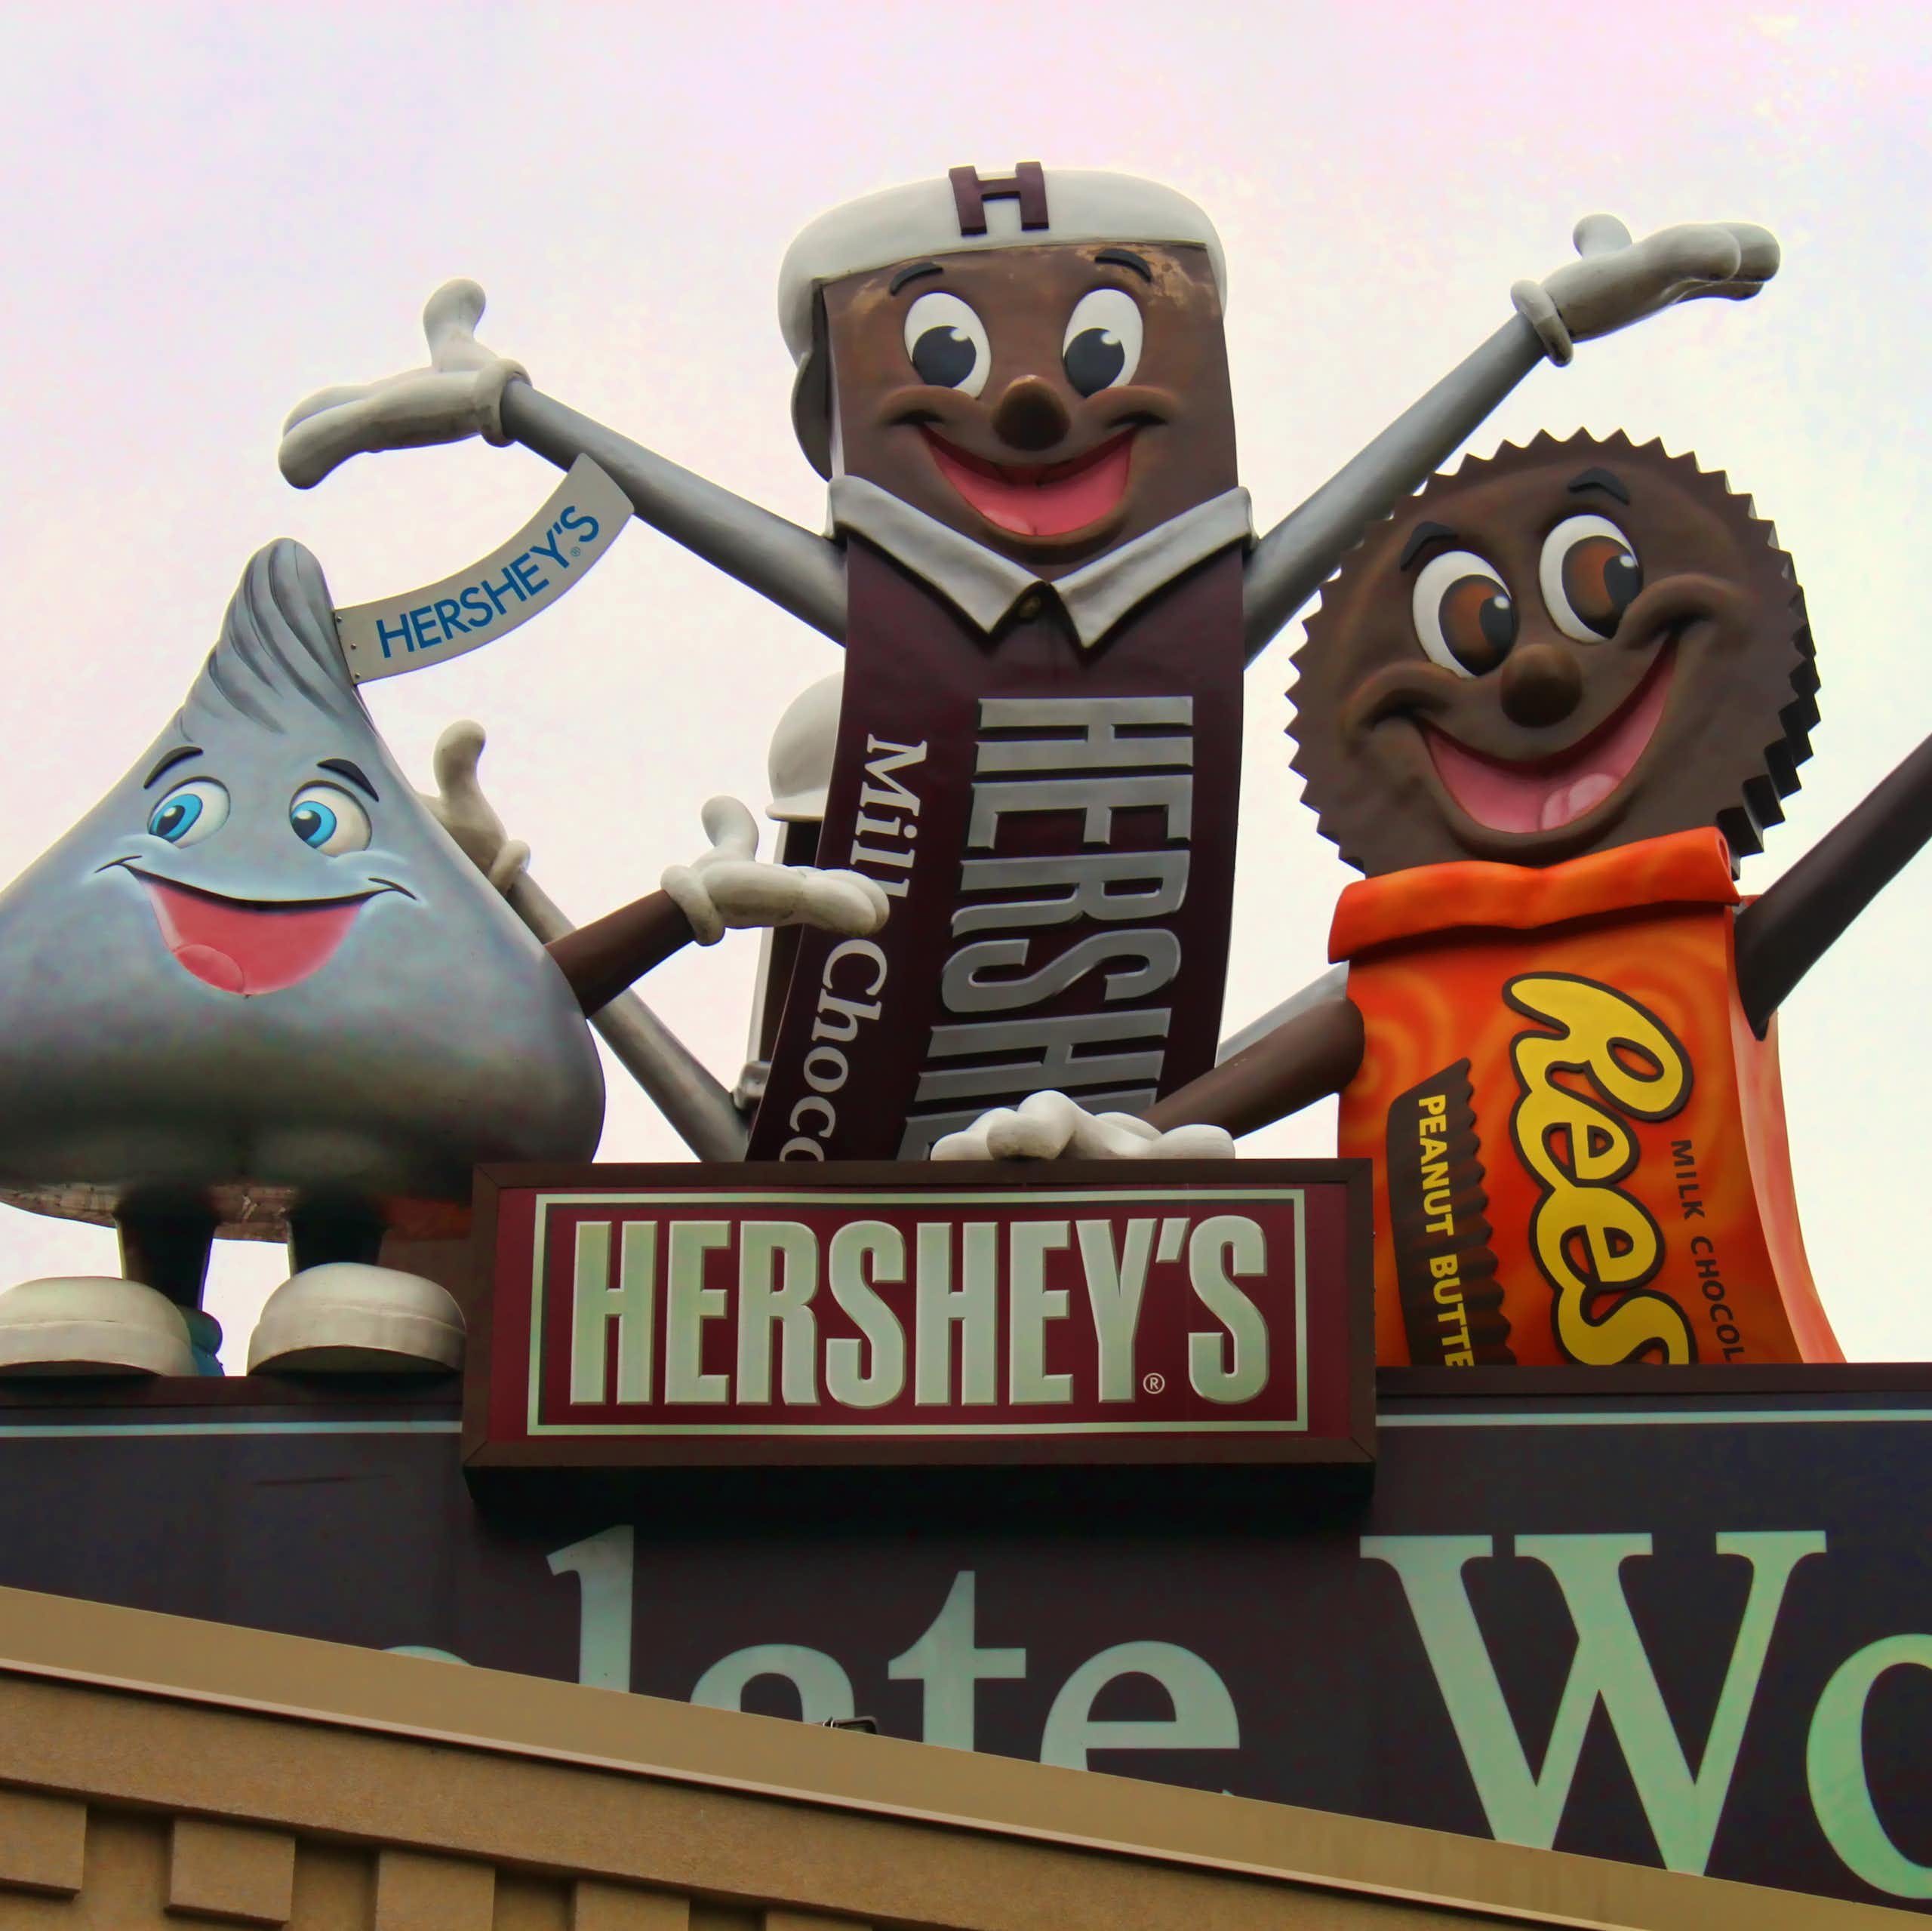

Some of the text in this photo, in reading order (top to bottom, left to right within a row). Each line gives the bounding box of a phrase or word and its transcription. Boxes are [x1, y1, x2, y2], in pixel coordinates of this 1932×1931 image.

[949, 161, 1050, 236] H
[376, 506, 600, 658] HERSHEY'S
[569, 1215, 1270, 1409] HERSHEY'S
[1418, 1094, 1475, 1367] PEANUT BUTTE
[1671, 1139, 1745, 1362] MILK CHOCOL
